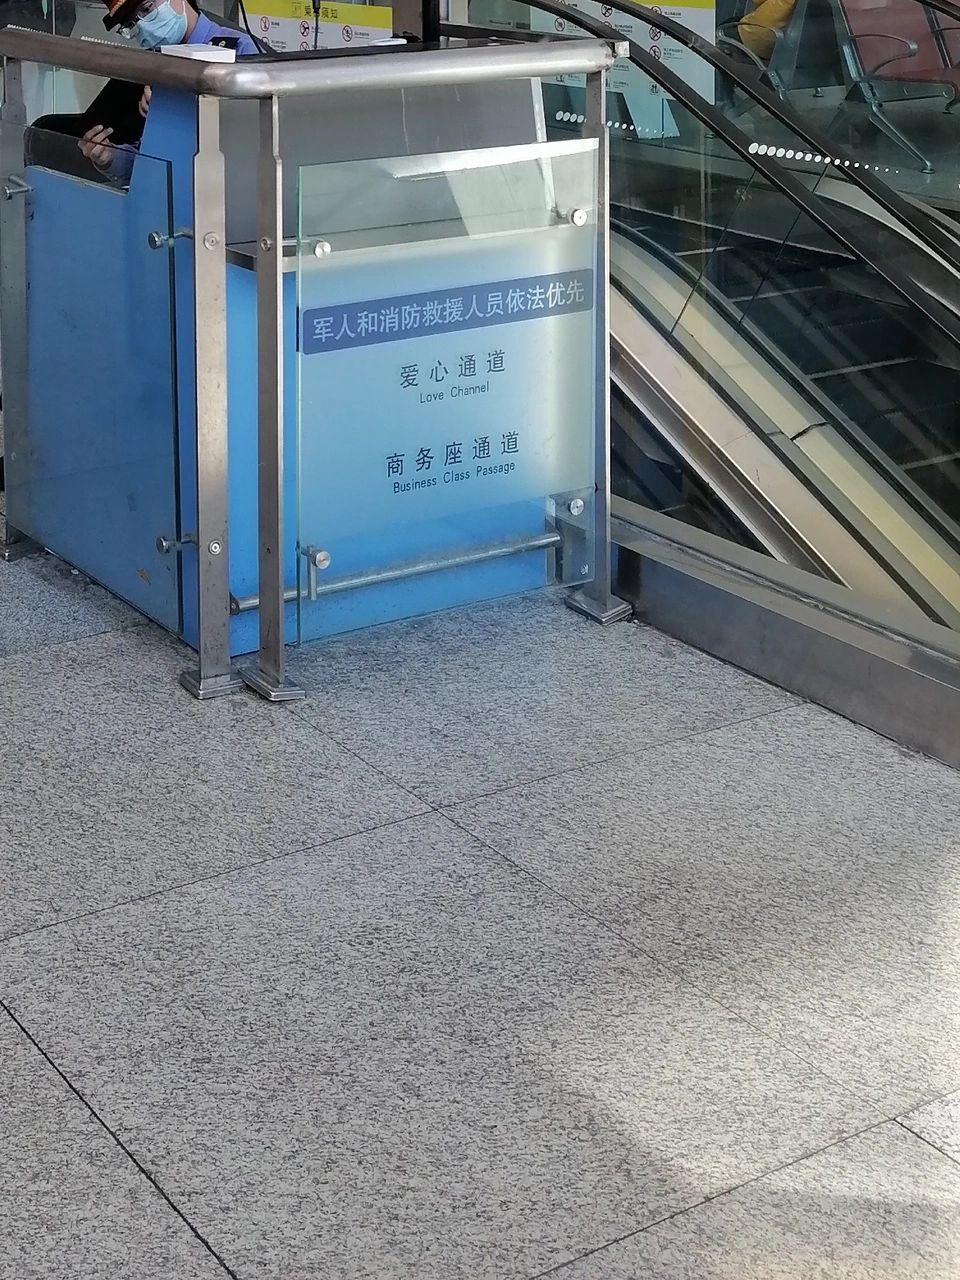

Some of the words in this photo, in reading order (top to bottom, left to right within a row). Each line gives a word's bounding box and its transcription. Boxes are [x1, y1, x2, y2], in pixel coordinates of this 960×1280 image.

[304, 4, 338, 19] 乘须知
[313, 279, 585, 343] 军人和消防救援人员依法优先
[400, 349, 507, 389] 爱心通道
[420, 391, 444, 404] Love
[450, 382, 490, 399] Channel
[386, 430, 520, 478] 商务座通道
[394, 475, 437, 494] Business
[443, 470, 470, 484] Class
[476, 460, 516, 478] Passage
